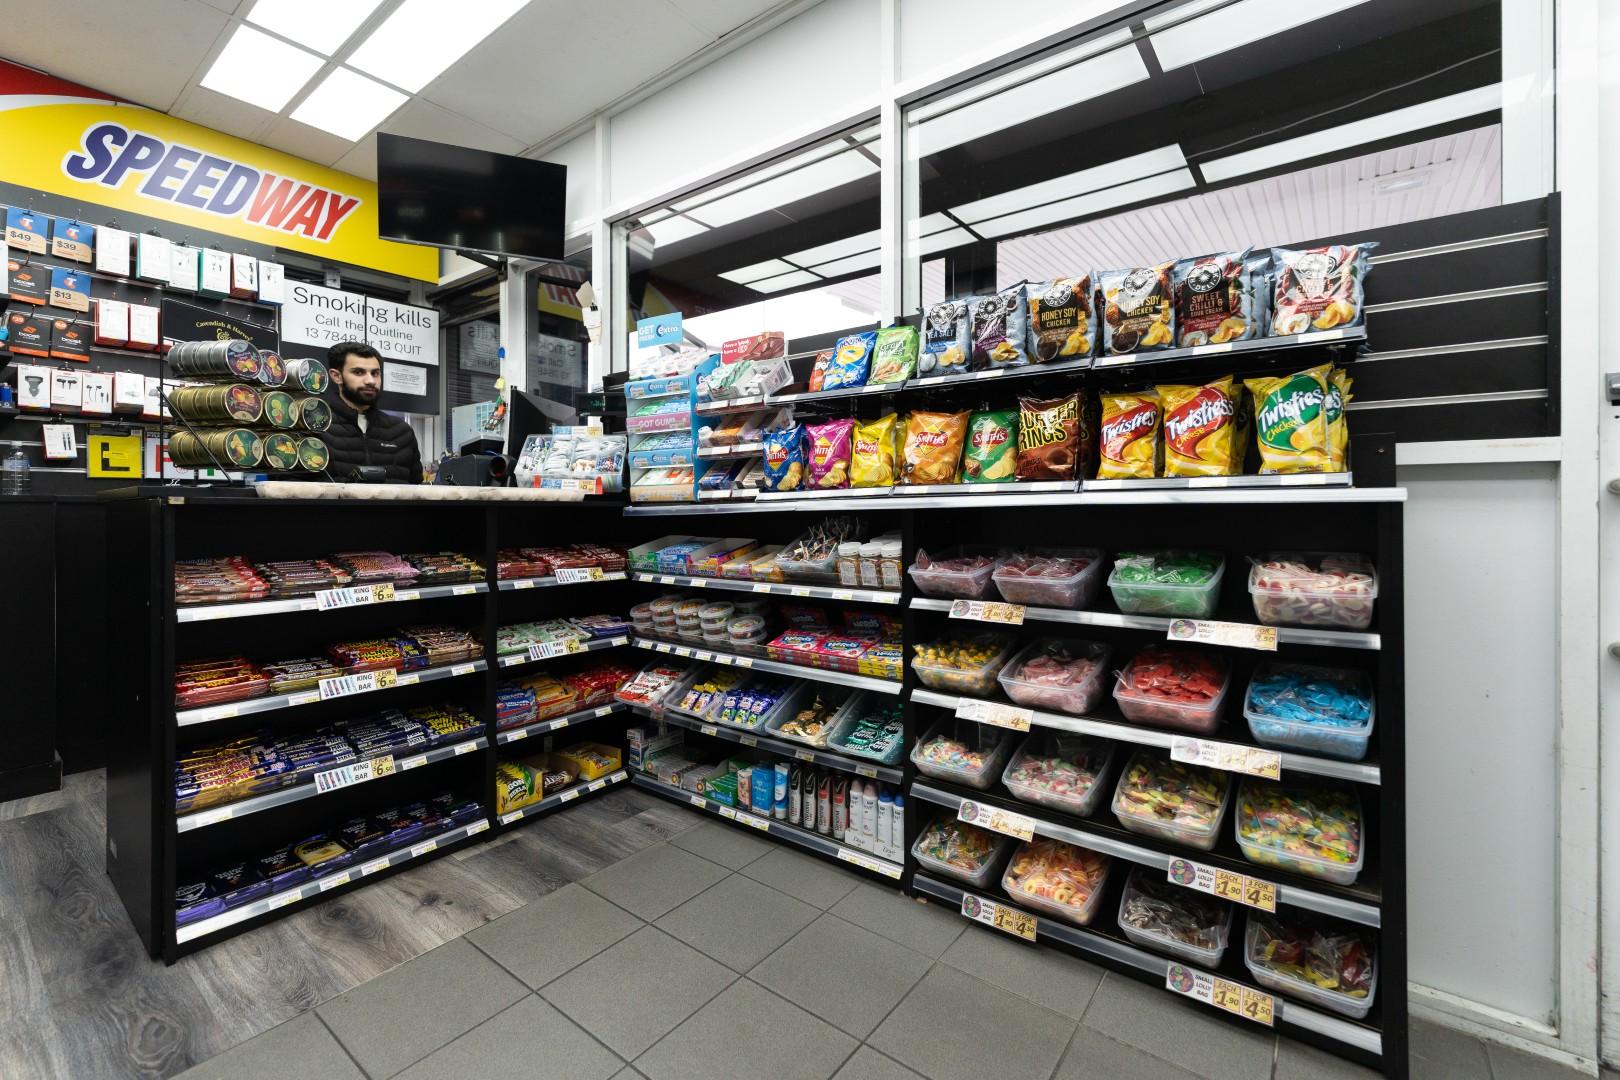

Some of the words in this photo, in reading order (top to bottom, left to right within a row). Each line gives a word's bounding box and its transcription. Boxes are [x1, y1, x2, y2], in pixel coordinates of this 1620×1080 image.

[65, 123, 362, 241] SPEEDWAY
[10, 230, 31, 242] $49
[56, 240, 76, 251] $39
[54, 290, 71, 300] $13
[1145, 295, 1160, 305] SOY
[1191, 292, 1219, 304] SWEET
[293, 286, 388, 323] Smoking
[395, 307, 432, 329] kills
[1126, 306, 1154, 317] CHICKEN
[1189, 301, 1215, 312] CHILLI
[1205, 307, 1223, 316] CREAM
[1041, 310, 1063, 322] HONEY
[1063, 307, 1076, 318] SOY
[195, 320, 225, 329] Cavendish
[315, 313, 340, 328] Call
[345, 319, 364, 332] the
[369, 324, 413, 341] Quitline
[1046, 318, 1071, 328] CHICKEN
[639, 325, 655, 335] GET
[940, 328, 954, 337] SALT
[305, 327, 319, 339] 13
[322, 329, 358, 343] 7848
[379, 340, 391, 351] 13
[394, 342, 422, 355] QUIT
[1019, 400, 1078, 430] BURGER
[1259, 389, 1324, 433] Twisties
[638, 418, 655, 428] GOT
[1166, 398, 1229, 440] Twisties
[1102, 409, 1156, 445] Twisties
[1019, 421, 1067, 452] RINGS
[1176, 427, 1205, 448] Cheese
[101, 442, 130, 471] L
[374, 589, 394, 601] $6.50
[353, 763, 369, 771] KING
[373, 764, 393, 776] $6.50
[1197, 866, 1214, 876] SMALL
[1197, 874, 1213, 883] LOLLY
[1220, 873, 1238, 884] EACH
[1198, 881, 1210, 889] BAG
[1216, 880, 1241, 896] $1.90
[1254, 881, 1268, 891] FOR
[1246, 888, 1273, 905] $4.50
[982, 902, 994, 911] SMALL
[998, 908, 1012, 917] EACH
[1022, 915, 1031, 923] FOR
[1015, 922, 1035, 935] $4.50
[1195, 974, 1212, 985] SMALL
[1195, 982, 1212, 991] LOLLY
[1218, 982, 1237, 993] EACH
[1197, 989, 1209, 998] BAG
[1215, 990, 1239, 1007] $1.90
[1252, 993, 1266, 1003] FOR
[1244, 1000, 1271, 1018] $4.50
